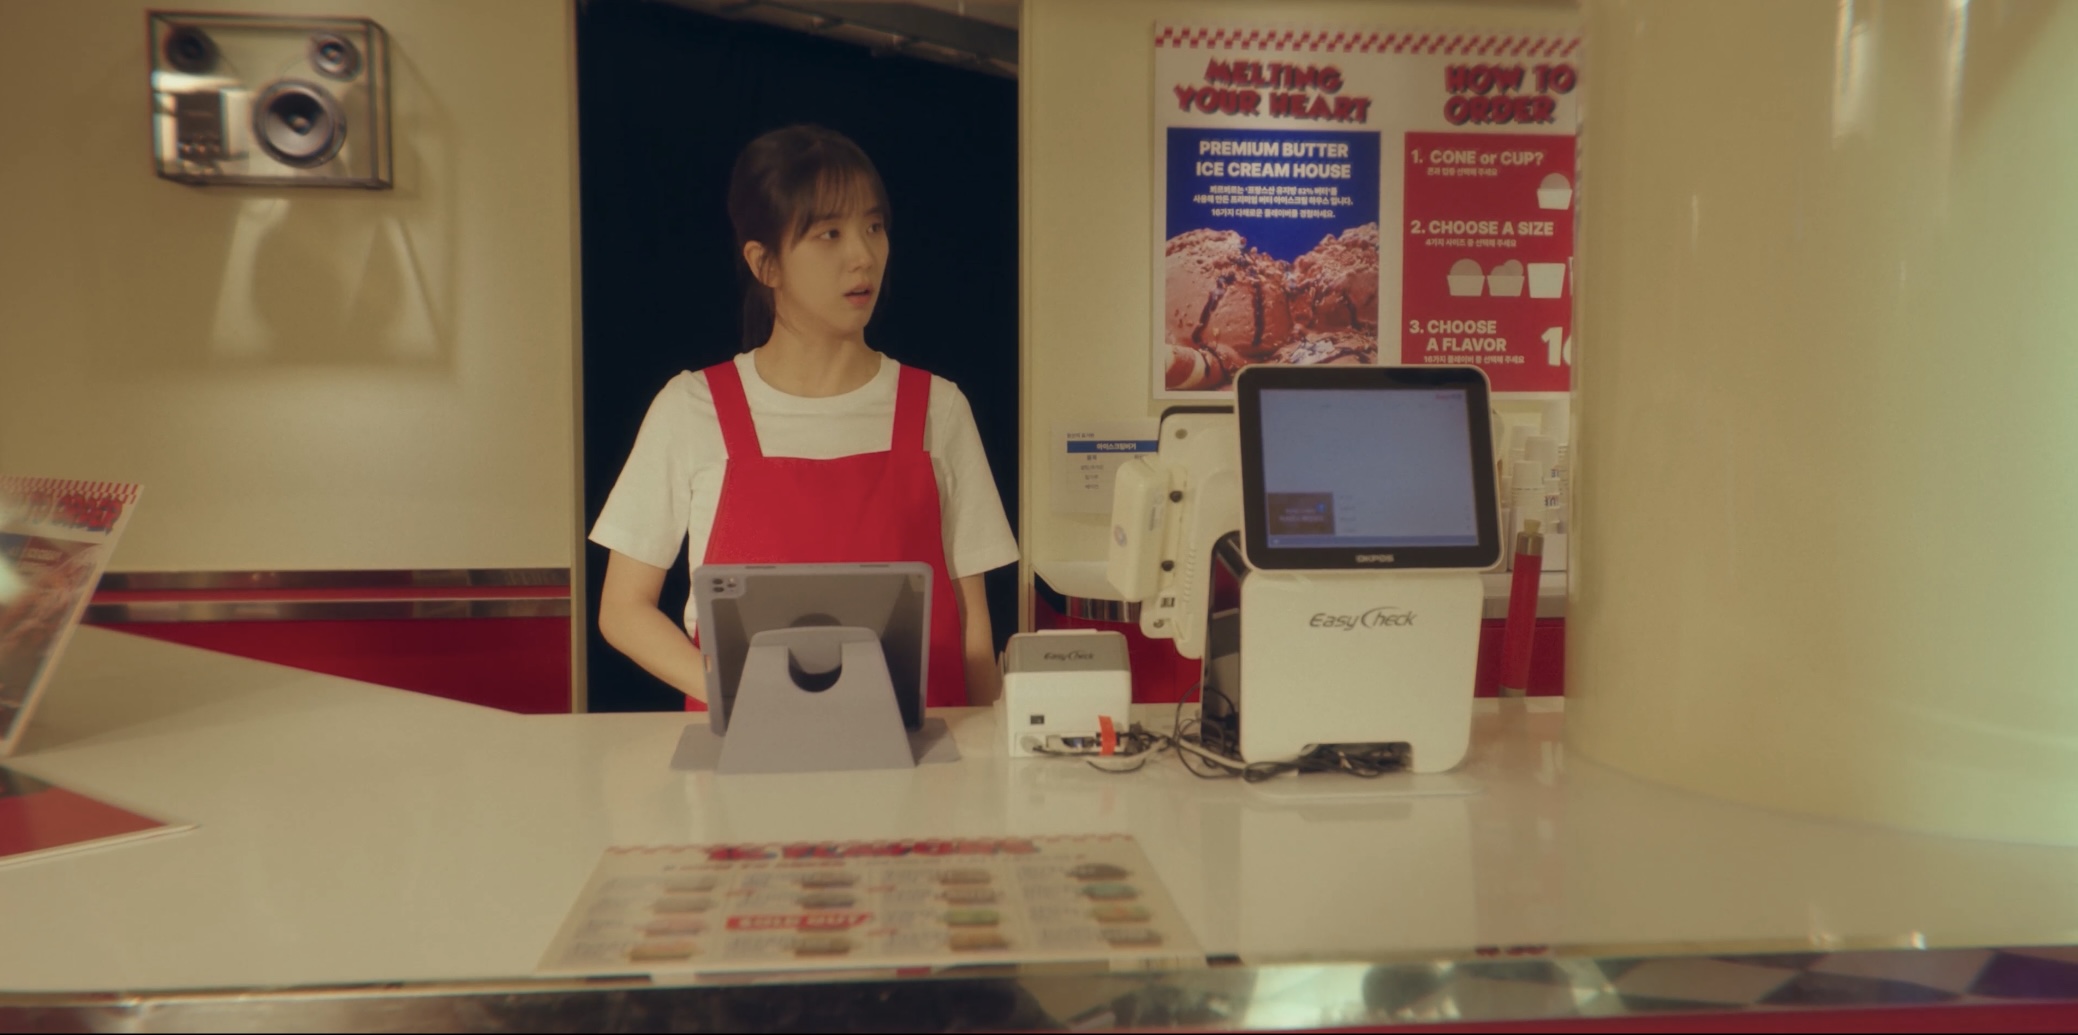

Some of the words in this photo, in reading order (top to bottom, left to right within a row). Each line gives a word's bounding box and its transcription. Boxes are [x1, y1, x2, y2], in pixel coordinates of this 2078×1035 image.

[1205, 57, 1344, 94] MELTING
[1445, 63, 1524, 95] HOW
[1533, 64, 1577, 94] TO
[1174, 84, 1262, 118] YOUR
[1269, 93, 1372, 124] HEART
[1444, 94, 1557, 125] ORDER
[1199, 140, 1279, 157] PREMIUM
[1282, 142, 1349, 158] BUTTER
[1411, 149, 1423, 164] 1.
[1430, 150, 1476, 165] CONE
[1480, 152, 1497, 165] or
[1500, 151, 1544, 166] CUP?
[1196, 161, 1224, 177] ICE
[1227, 162, 1290, 178] CREAM
[1292, 163, 1351, 179] HOUSE
[1230, 195, 1258, 205] 프리미엄
[1273, 196, 1308, 205] 아이스크림
[1308, 196, 1330, 205] 하우스
[1211, 208, 1235, 217] 16가지
[1235, 208, 1263, 218] 다채로운
[1264, 208, 1298, 218] 플레이버를
[1411, 219, 1425, 234] 2.
[1429, 220, 1498, 235] CHOOSE
[1502, 221, 1515, 235] A
[1518, 221, 1554, 236] SIZE
[1425, 238, 1444, 247] 4가지
[1446, 238, 1466, 247] 사이즈
[1409, 319, 1424, 334] 3.
[1427, 320, 1497, 334] CHOOSE
[1426, 338, 1439, 352] A
[1442, 338, 1507, 352] FLAVOR
[1424, 355, 1446, 364] 16가지
